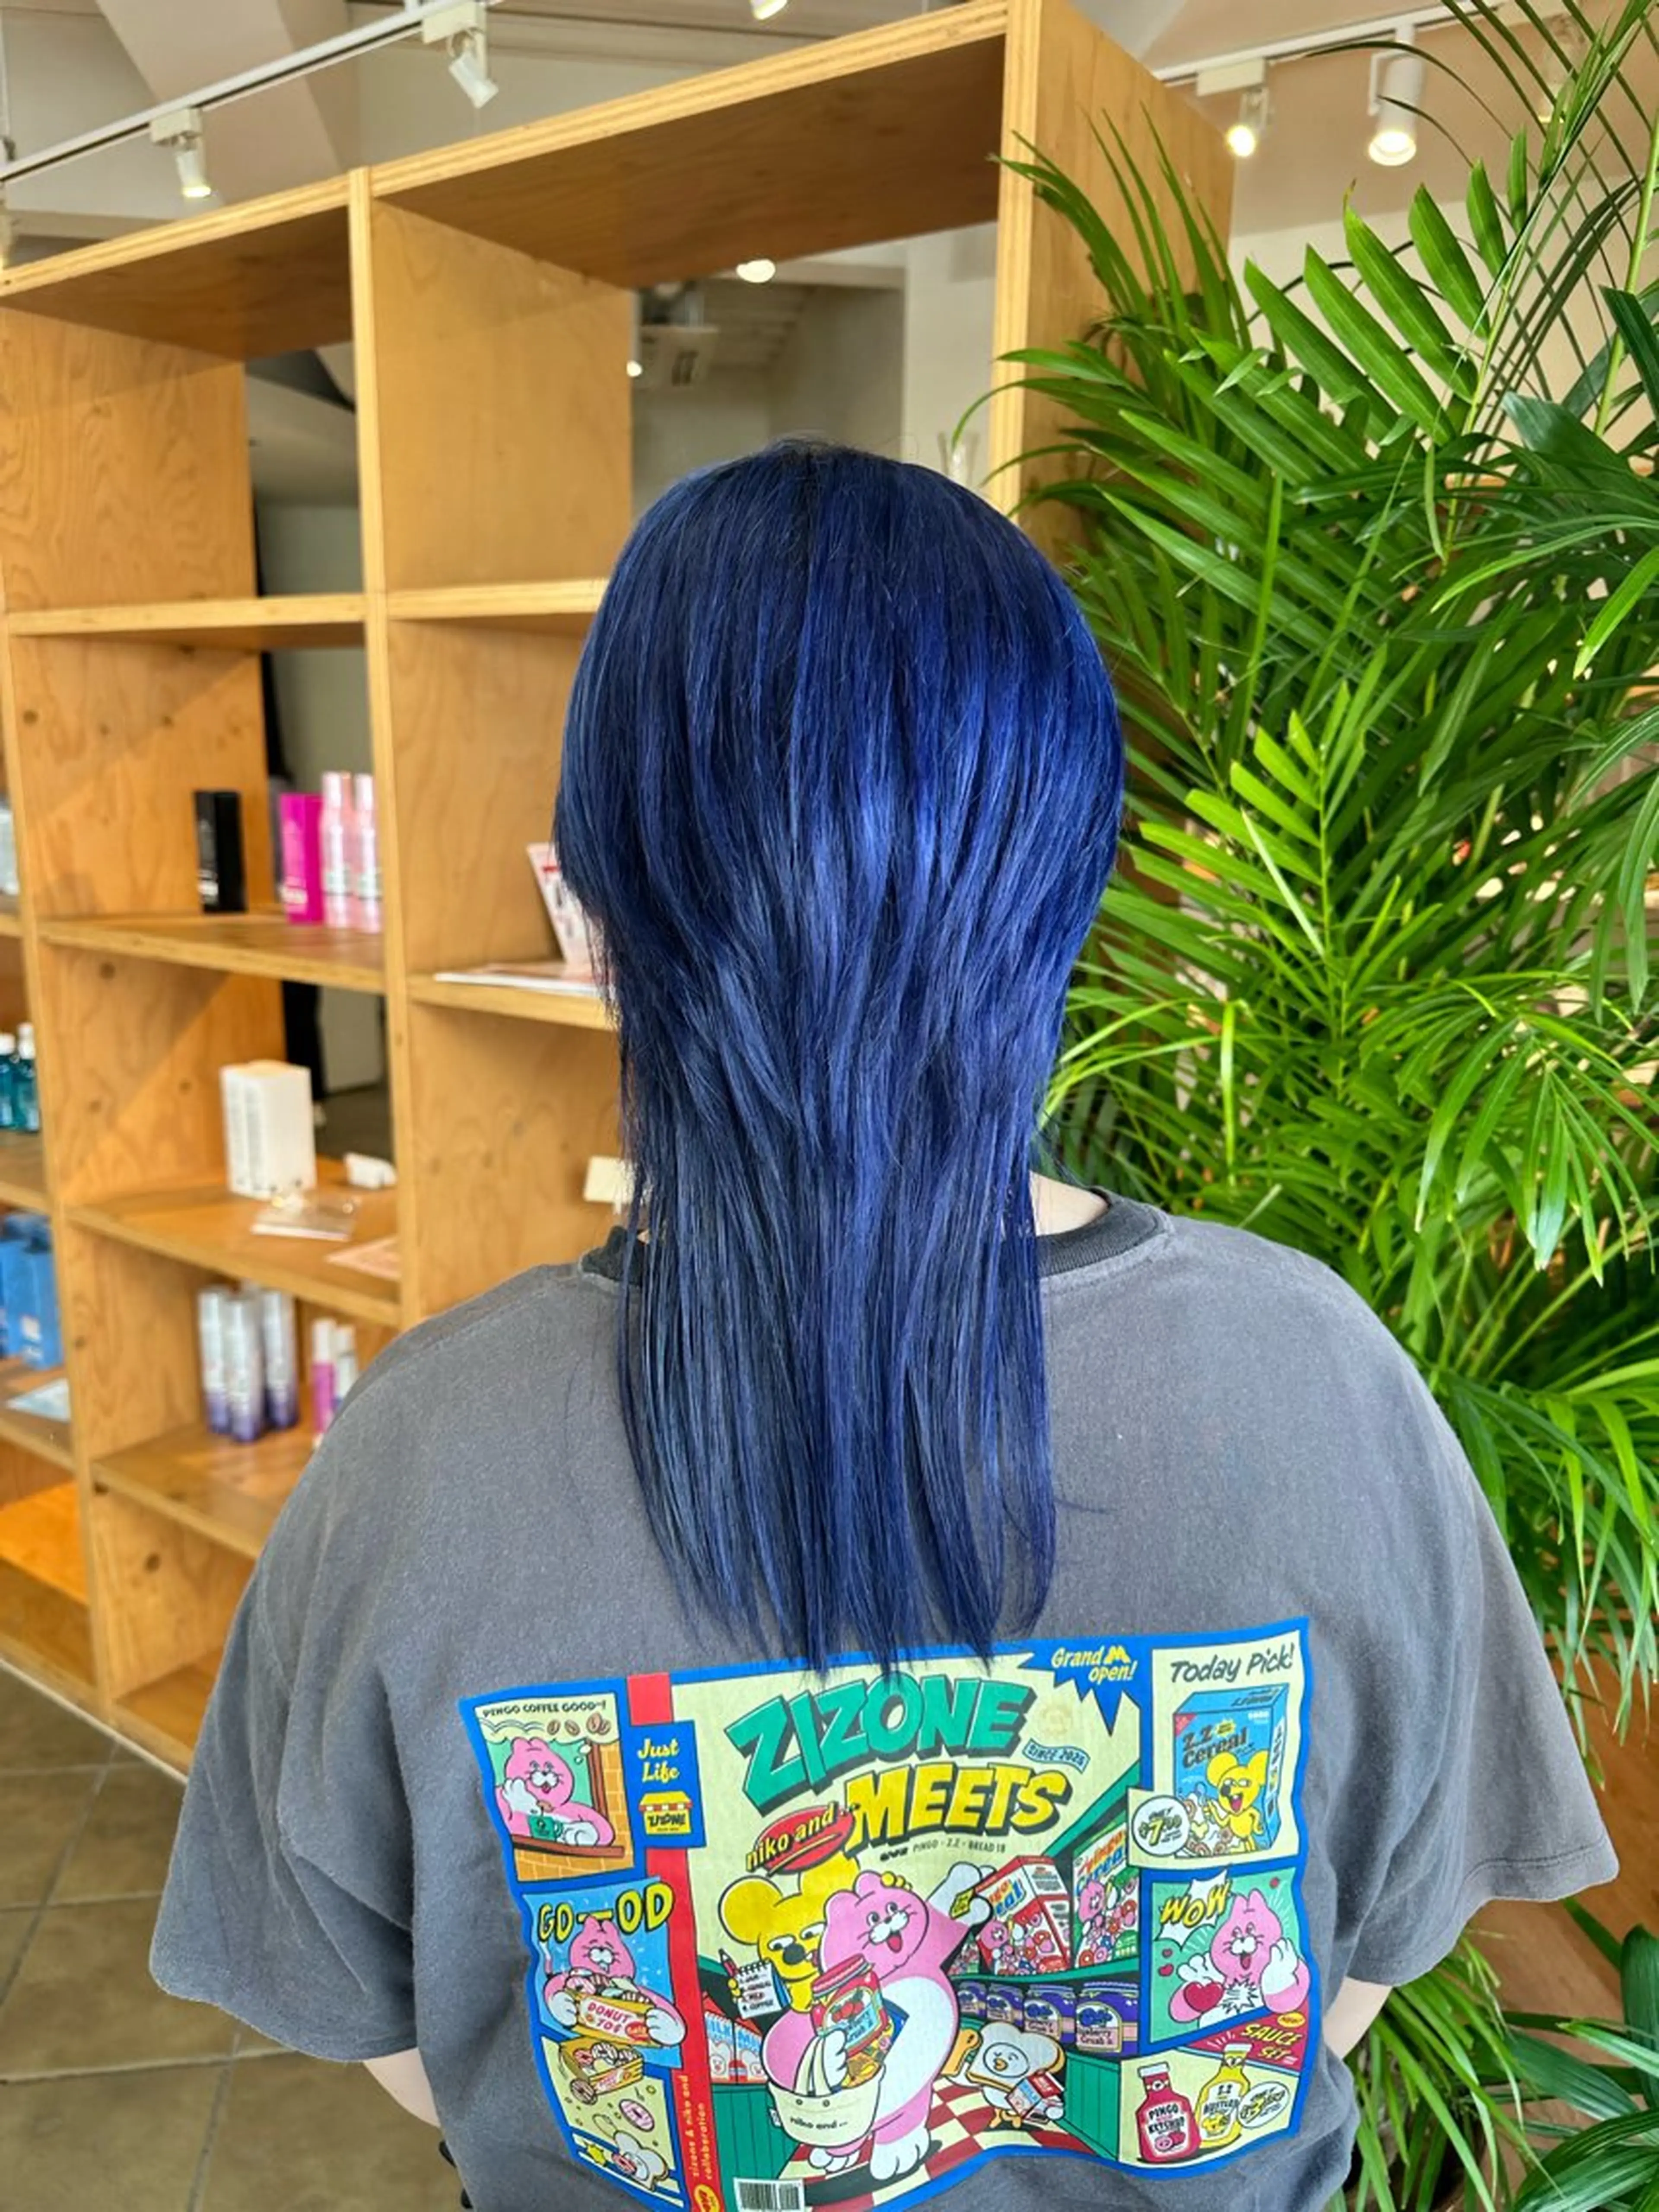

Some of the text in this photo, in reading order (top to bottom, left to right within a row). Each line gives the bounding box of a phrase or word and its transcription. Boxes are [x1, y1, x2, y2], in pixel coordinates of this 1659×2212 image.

[1051, 1645, 1105, 1669] Grand
[1170, 1641, 1295, 1683] Today Pick!
[1087, 1660, 1138, 1685] open!
[523, 1703, 560, 1713] COFFEE
[637, 1738, 680, 1759] Just
[725, 1671, 1038, 1817] ZIZONE
[642, 1760, 680, 1784] Life
[844, 1762, 1073, 1858] MEETS
[746, 1801, 839, 1873] niko and
[1159, 1878, 1233, 1929] WOW
[587, 2002, 632, 2024] DONUT
[1240, 2023, 1303, 2047] SAUCE
[1148, 2102, 1179, 2120] PINGO
